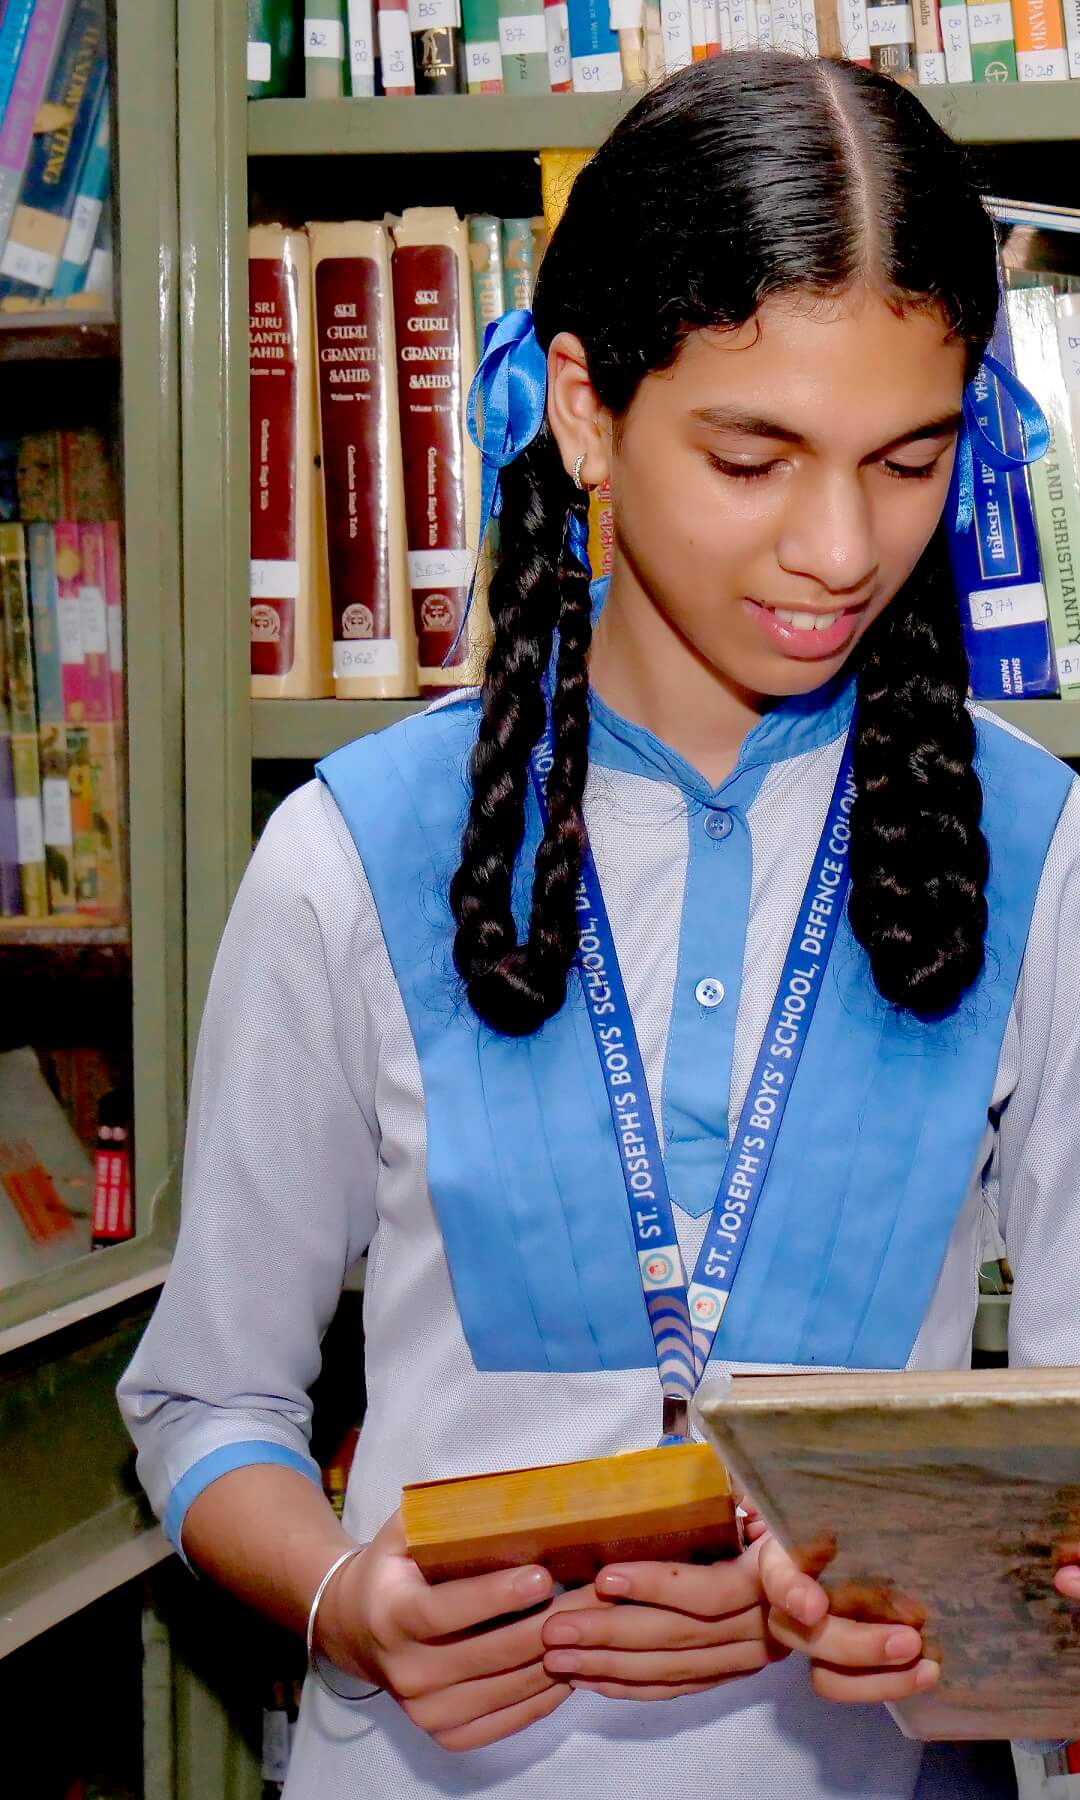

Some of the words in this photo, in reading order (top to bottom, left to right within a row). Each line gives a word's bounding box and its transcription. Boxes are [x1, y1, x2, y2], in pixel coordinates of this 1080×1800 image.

[974, 15, 1001, 27] B27
[1028, 0, 1049, 49] PANIO
[505, 28, 526, 41] B7
[354, 39, 367, 62] B3
[472, 53, 490, 66] B6
[554, 45, 567, 68] B8
[582, 66, 600, 81] B9
[1024, 65, 1054, 78] B28
[414, 290, 439, 305] SRI
[254, 302, 276, 313] SRI
[334, 303, 357, 318] SRI
[326, 325, 368, 339] GURU
[407, 316, 449, 332] GURU
[249, 333, 291, 344] RANTH
[321, 347, 377, 362] GRANTH
[401, 346, 459, 361] GRANTH
[328, 368, 370, 383] SAHIB
[409, 374, 452, 389] SAHIB
[1046, 463, 1064, 501] AND
[1000, 658, 1011, 695] PANDEY
[1011, 657, 1023, 693] SHASTRI
[800, 860, 844, 956] DEFENCE
[577, 916, 616, 1015] SCHOOL,
[772, 962, 820, 1059] SCHOOL,
[601, 1022, 632, 1086] BOYS'
[749, 1063, 784, 1130] BOYS'
[615, 1091, 655, 1199] JOSEPH'S
[716, 1135, 766, 1247] JOSEPH'S
[637, 1206, 662, 1240] ST.
[705, 1246, 732, 1279] ST.
